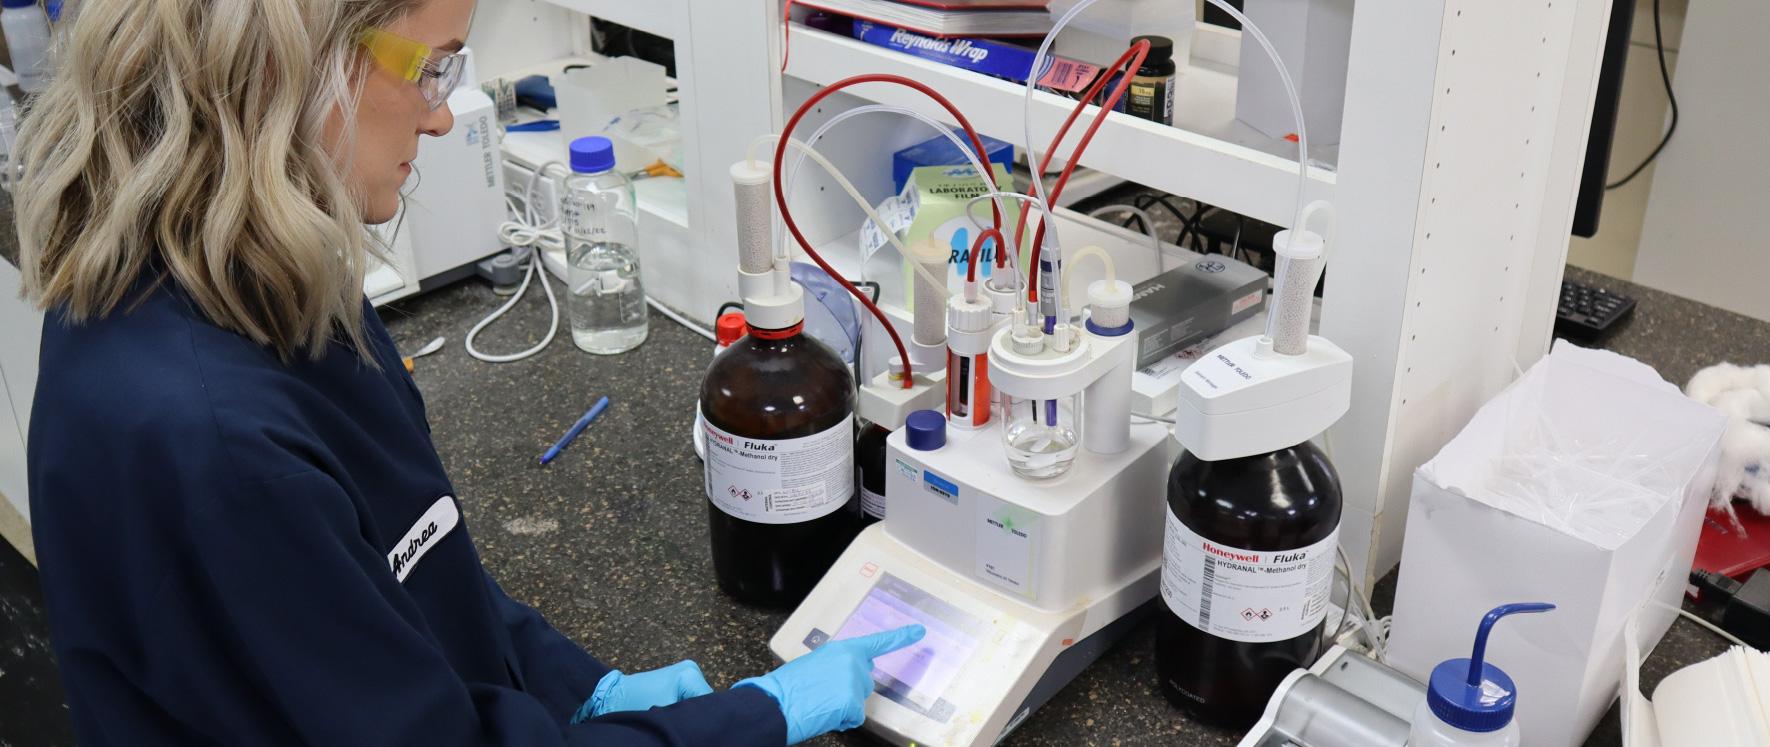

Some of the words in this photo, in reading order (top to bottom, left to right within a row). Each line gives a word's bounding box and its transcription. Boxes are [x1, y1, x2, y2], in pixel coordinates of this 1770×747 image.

[890, 28, 950, 53] Reynolds
[950, 38, 988, 63] Wrap
[479, 115, 491, 150] TOLEDO
[483, 151, 495, 188] METTLER
[929, 185, 1002, 193] LABORATOY
[744, 441, 775, 451] Fluka
[767, 452, 778, 461] dry
[393, 521, 438, 578] Andrea
[1203, 542, 1260, 563] Honeywell
[1273, 552, 1307, 563] Fluka
[1297, 563, 1307, 571] dry
